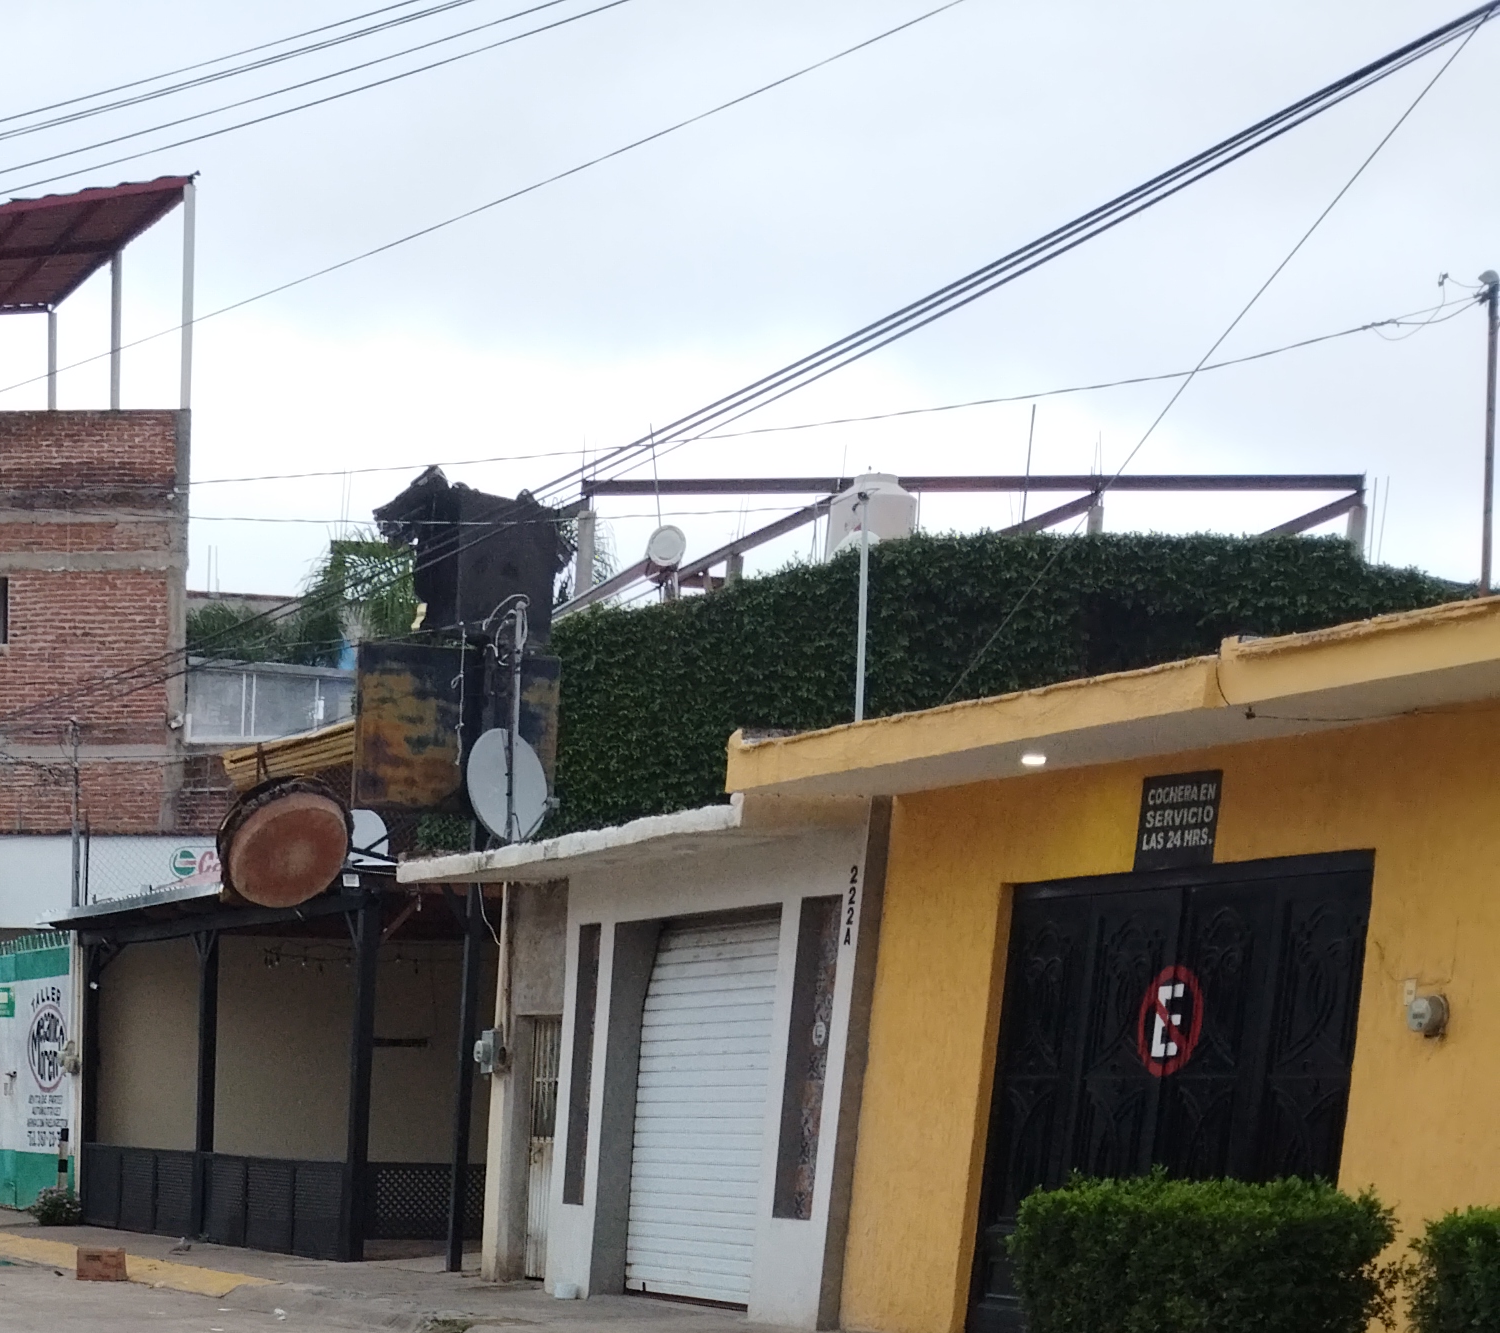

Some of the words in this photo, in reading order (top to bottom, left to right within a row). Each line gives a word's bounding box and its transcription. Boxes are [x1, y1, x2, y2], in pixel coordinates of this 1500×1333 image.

[1148, 784, 1198, 805] COCHERA
[1200, 783, 1217, 801] EN
[1145, 805, 1214, 828] SERVICIO
[1142, 832, 1164, 850] LAS
[1166, 830, 1182, 848] 24
[1183, 827, 1213, 847] HRS.
[31, 986, 61, 1013] TALLER
